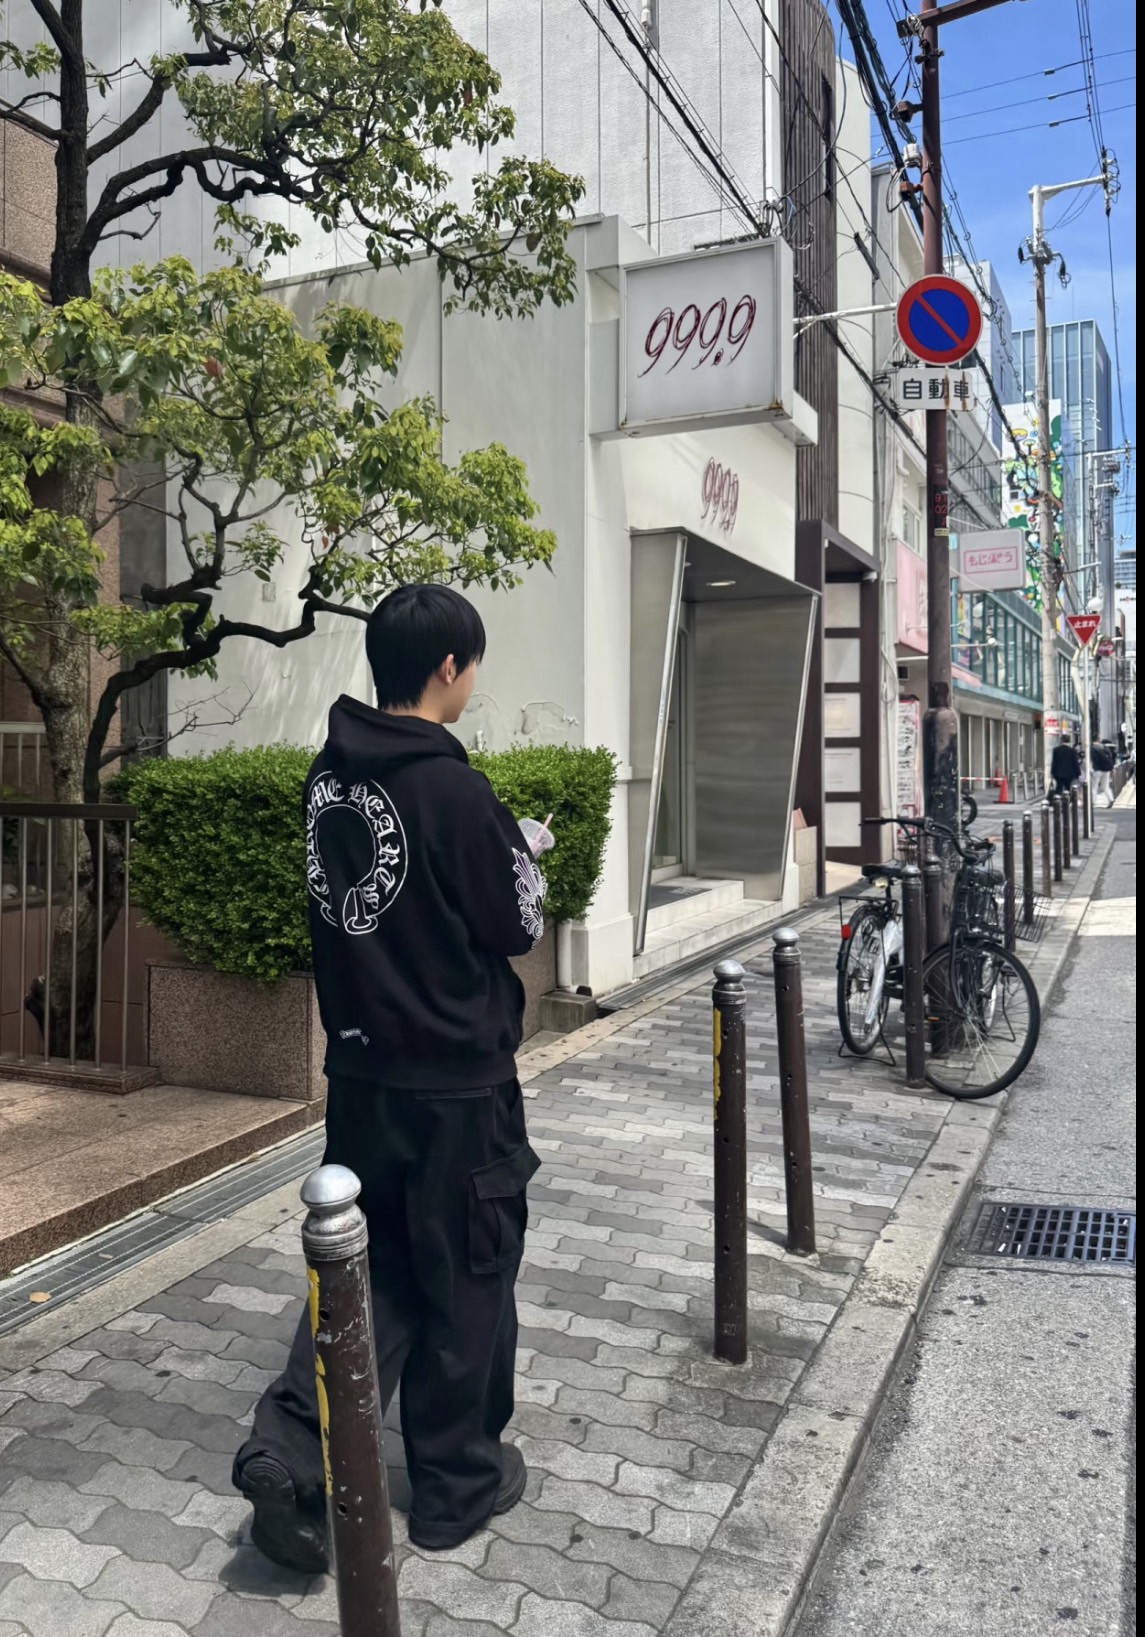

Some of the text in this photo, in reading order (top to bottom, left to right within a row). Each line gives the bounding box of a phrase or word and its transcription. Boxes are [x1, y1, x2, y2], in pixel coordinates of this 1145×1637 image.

[638, 294, 756, 378] 999.9
[903, 377, 971, 401] 自動車
[347, 781, 400, 910] HEARTS
